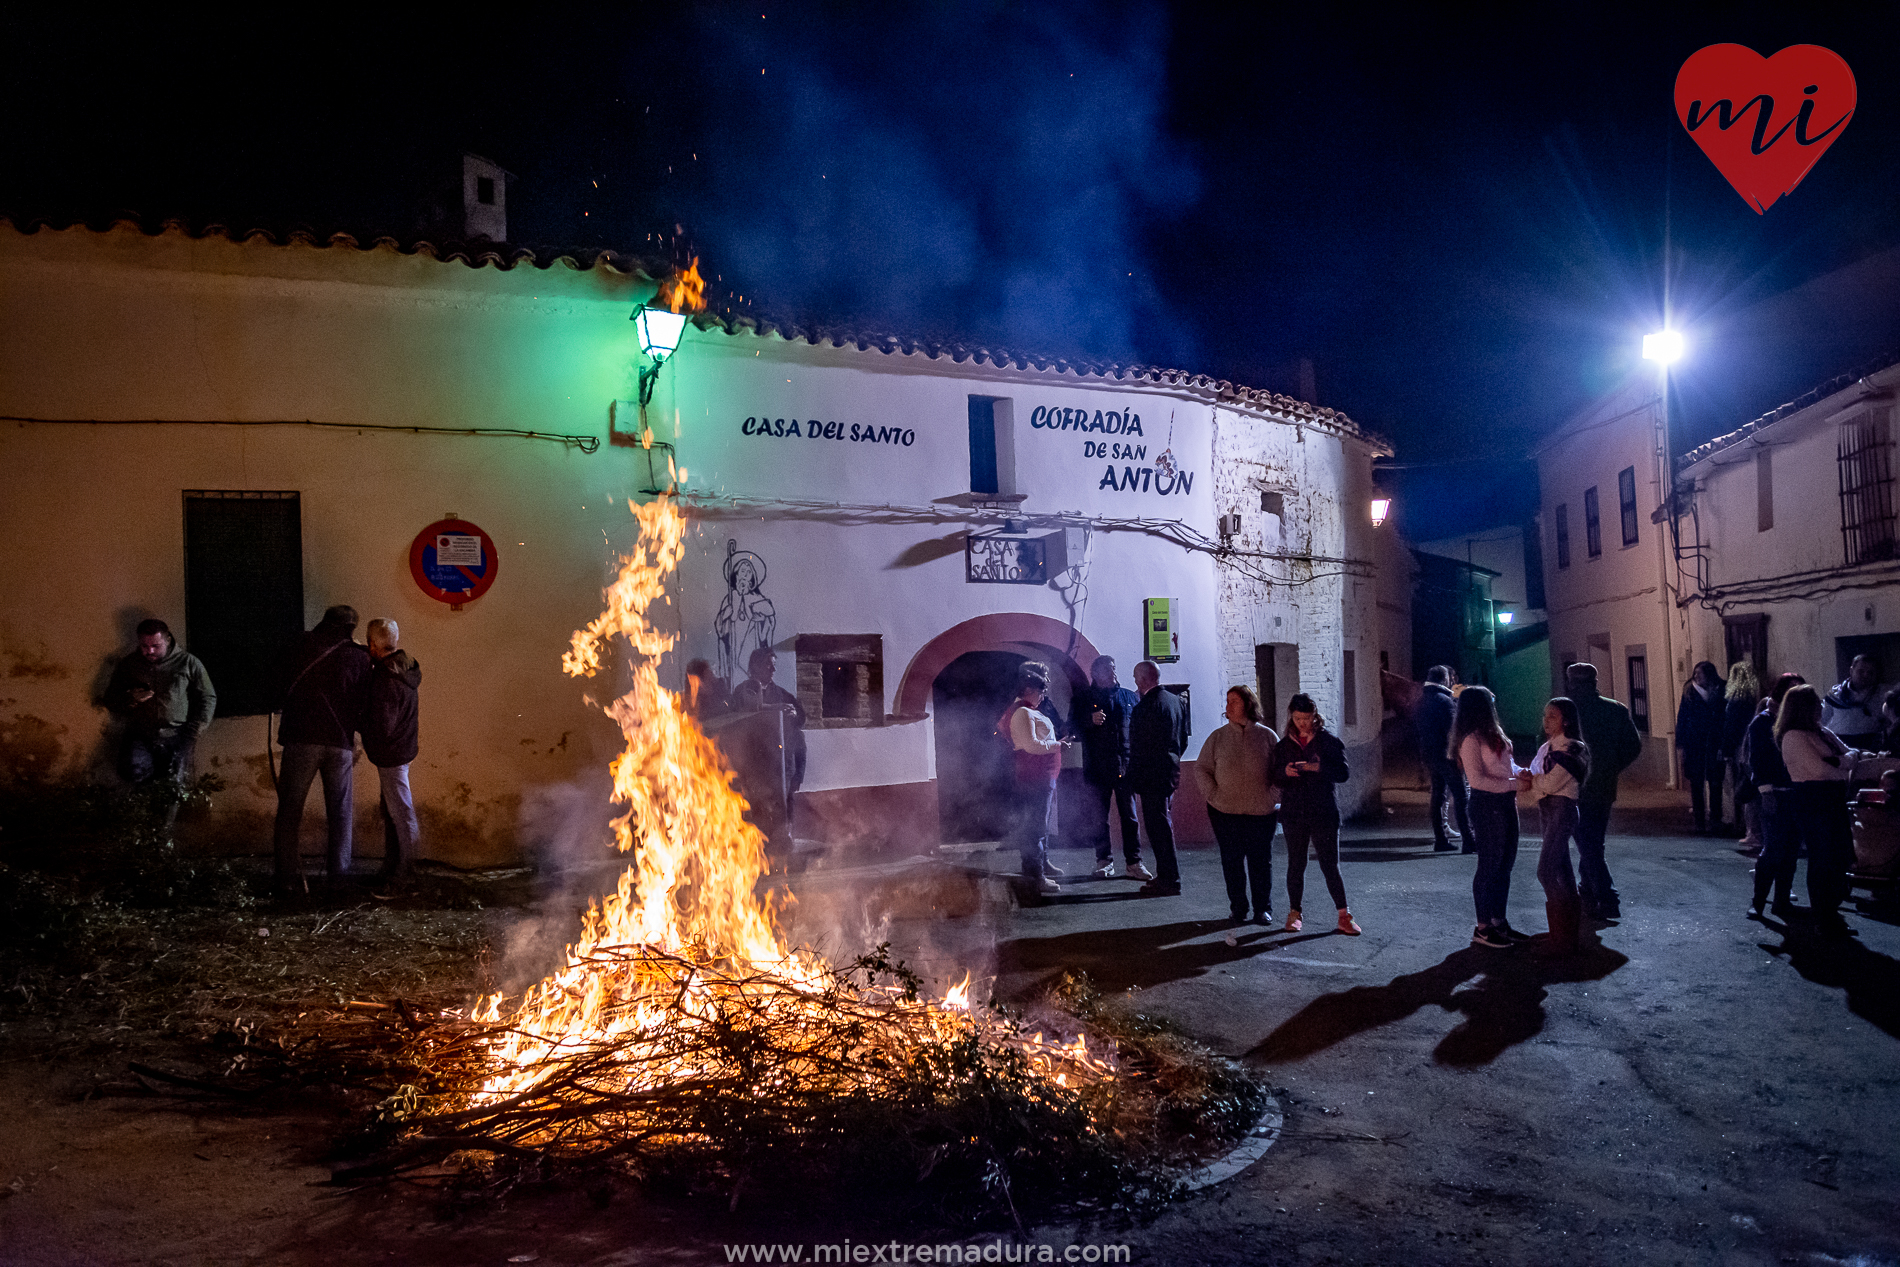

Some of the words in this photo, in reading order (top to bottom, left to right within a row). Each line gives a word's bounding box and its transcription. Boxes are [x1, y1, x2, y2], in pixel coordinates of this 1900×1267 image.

[742, 417, 802, 438] CASA
[807, 420, 845, 441] DEL
[850, 423, 915, 446] SANTO
[1030, 405, 1144, 437] COFRADÍA
[1083, 440, 1107, 458] DE
[1111, 442, 1147, 461] SAN
[971, 540, 1013, 556] CASA
[971, 564, 1020, 580] SANTO
